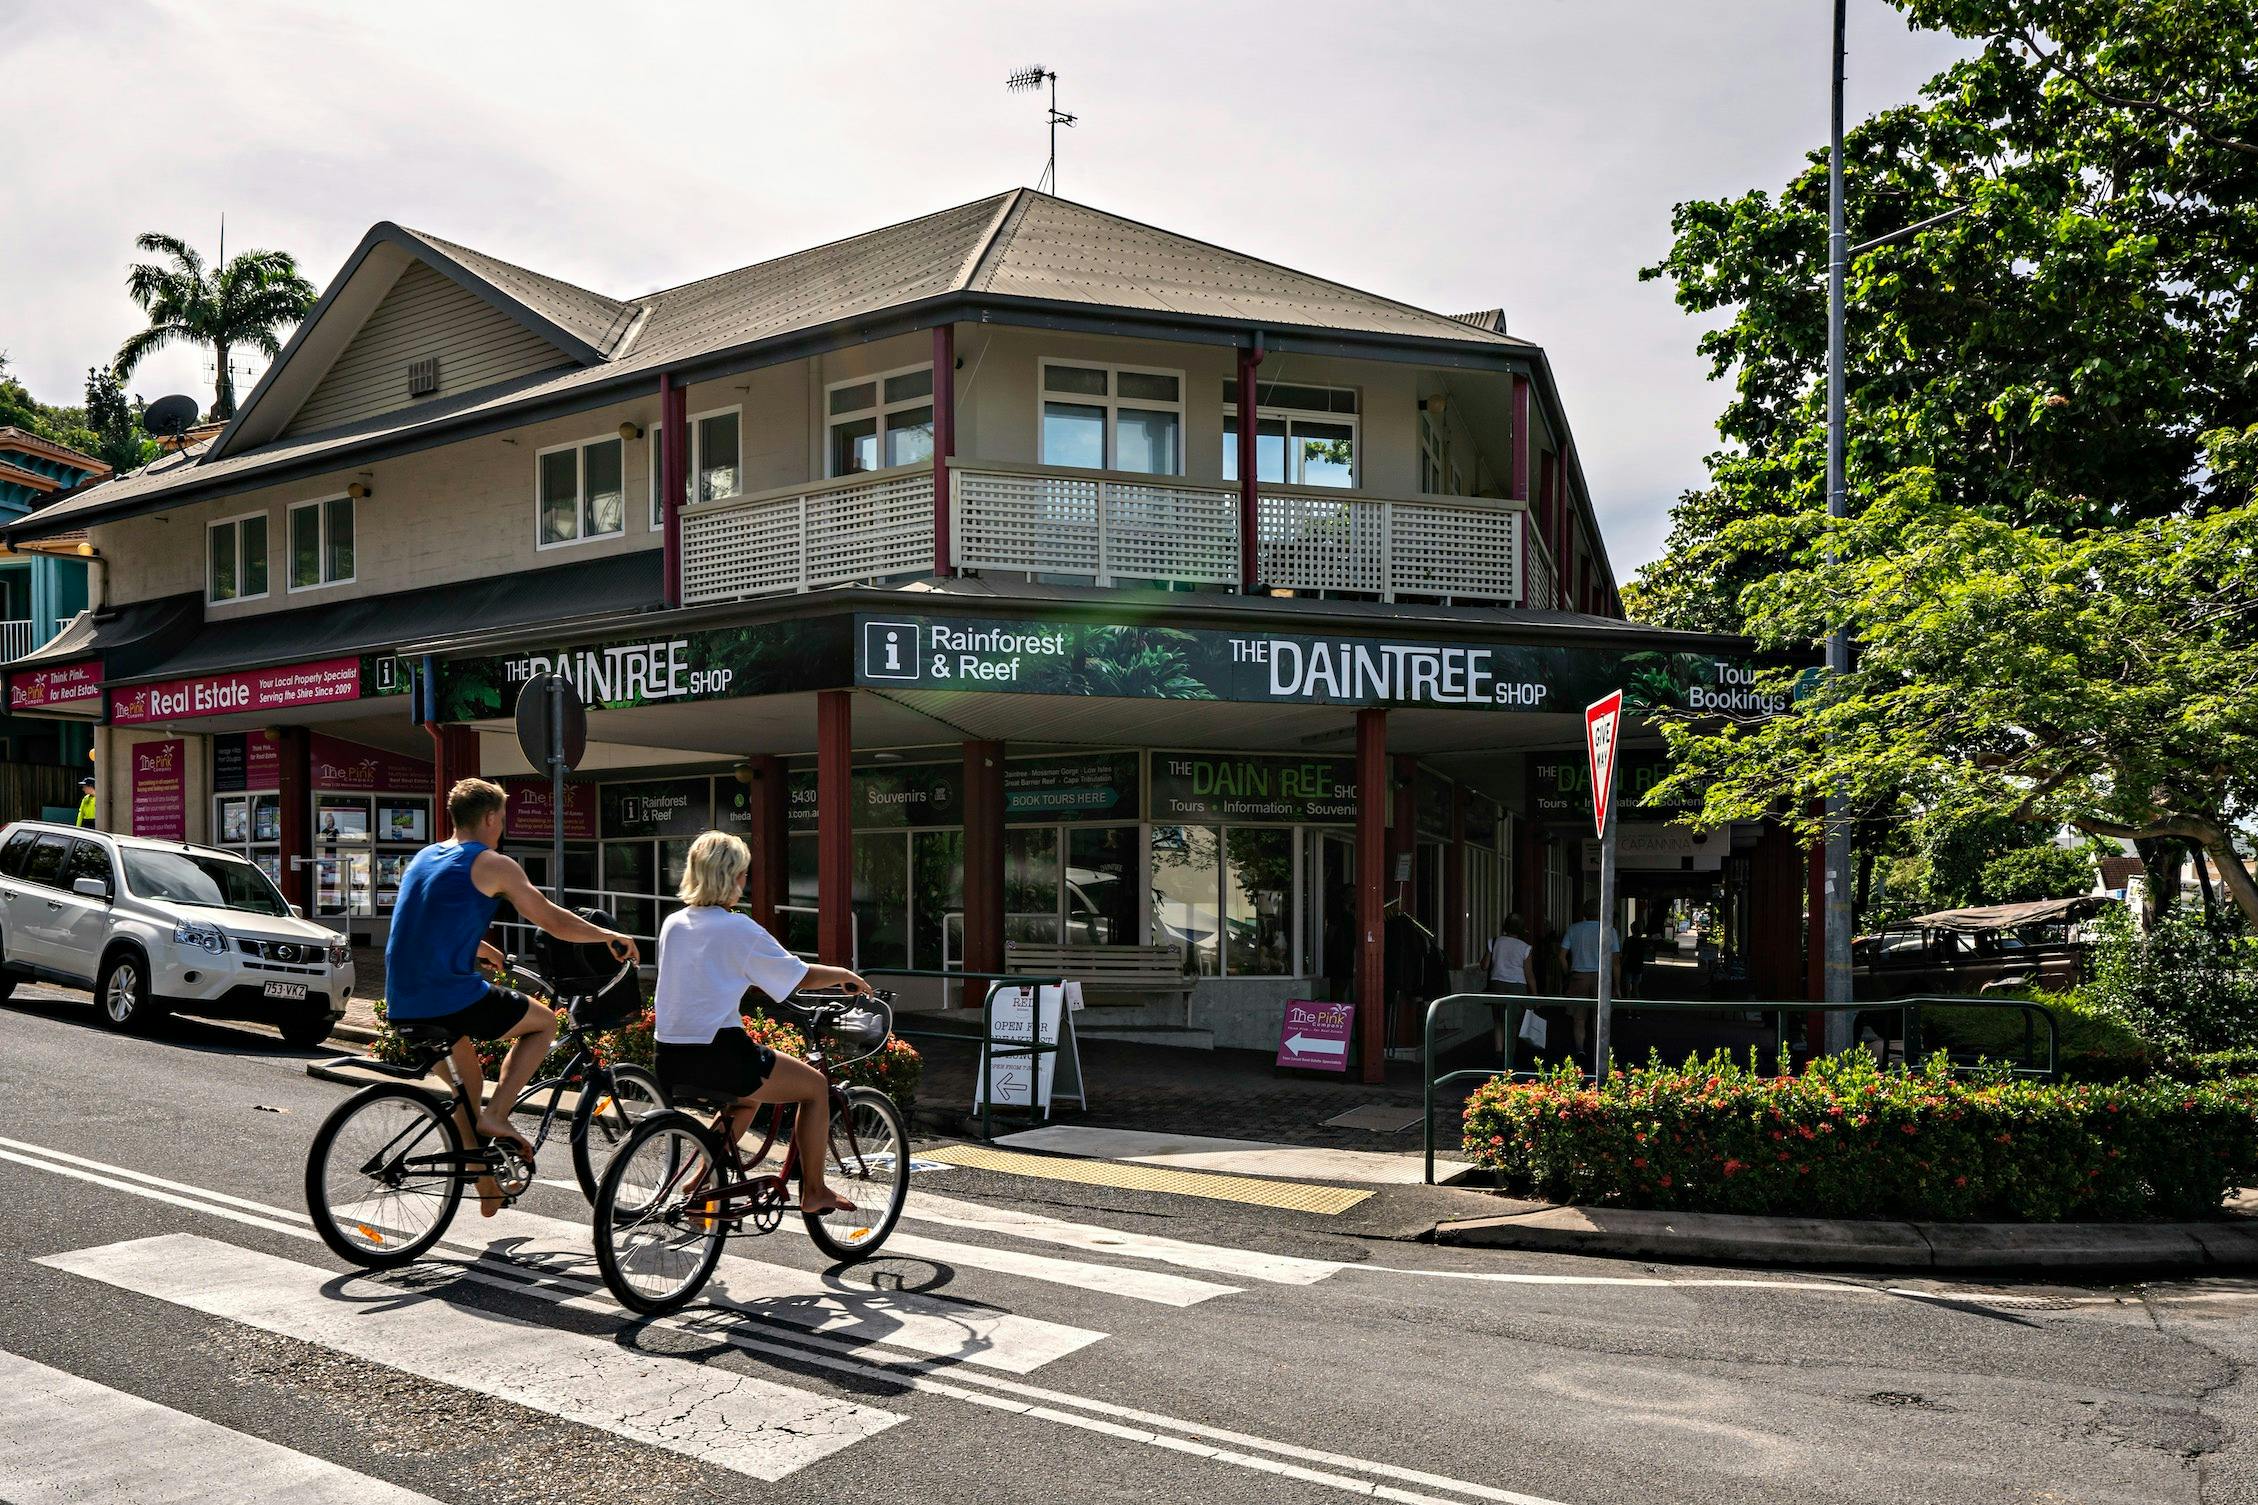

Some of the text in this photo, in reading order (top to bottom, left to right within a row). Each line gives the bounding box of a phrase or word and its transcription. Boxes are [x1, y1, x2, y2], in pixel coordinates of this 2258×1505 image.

[930, 624, 1064, 656] Rainforest
[930, 654, 1020, 681] & Reef
[1229, 639, 1268, 663] THE
[1495, 682, 1547, 705] SHOP
[50, 672, 68, 684] Think
[259, 668, 357, 689] Your Local Property Specialist
[505, 658, 528, 682] THE
[690, 669, 732, 694] SHOP
[12, 686, 44, 704] The Pink
[50, 684, 98, 700] for Real Estate
[151, 680, 250, 716] Real Estate
[260, 683, 351, 703] Serving the Shire Since 2009
[1690, 686, 1786, 715] Bookings
[1595, 722, 1610, 747] GIVE
[140, 754, 155, 771] The
[1597, 751, 1608, 769] WAY
[320, 764, 346, 779] The
[1168, 761, 1192, 776] THE
[1334, 785, 1357, 798] SHO
[1537, 766, 1557, 778] THE
[520, 788, 546, 804] The
[642, 794, 687, 808] Rainforest
[868, 789, 926, 804] Souvenirs
[1012, 792, 1106, 806] BOOK TOURS HERE
[1537, 798, 1568, 809] Tours
[1169, 799, 1357, 815] Tours Information Souveni
[642, 810, 672, 821] & Reef
[1289, 1008, 1344, 1024] The Pink
[995, 1021, 1048, 1032] OPEN FR
